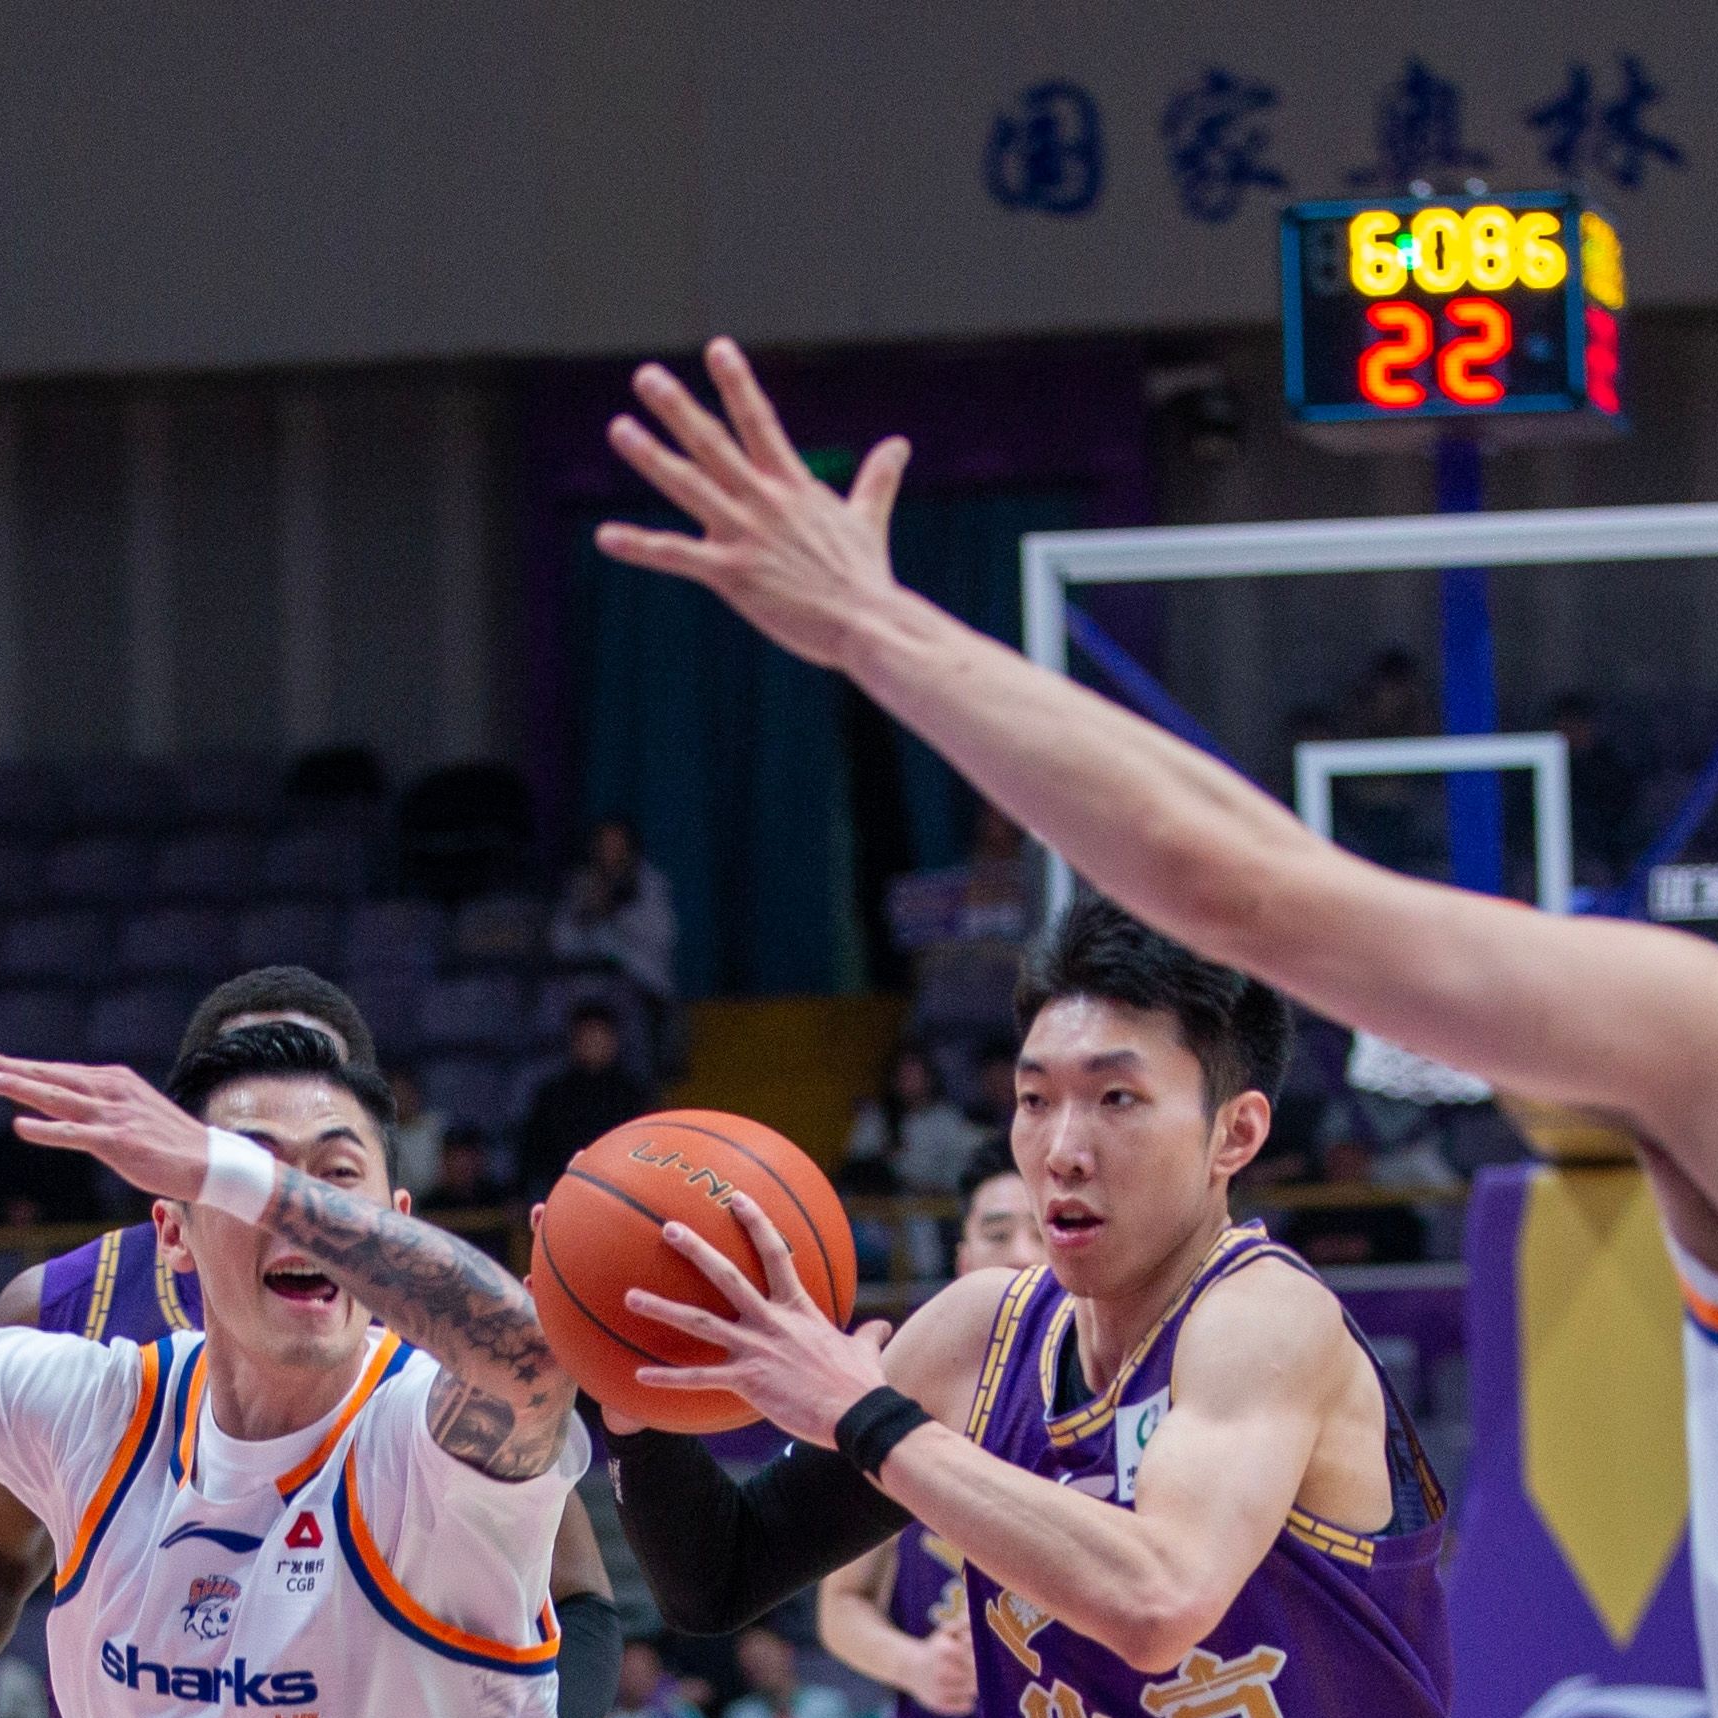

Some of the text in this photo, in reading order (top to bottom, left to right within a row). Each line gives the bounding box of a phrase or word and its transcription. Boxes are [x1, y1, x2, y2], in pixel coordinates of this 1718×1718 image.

[1357, 297, 1514, 409] 22
[277, 1558, 325, 1575] 广发银行
[286, 1578, 316, 1592] CGB
[101, 1640, 319, 1707] sharks
